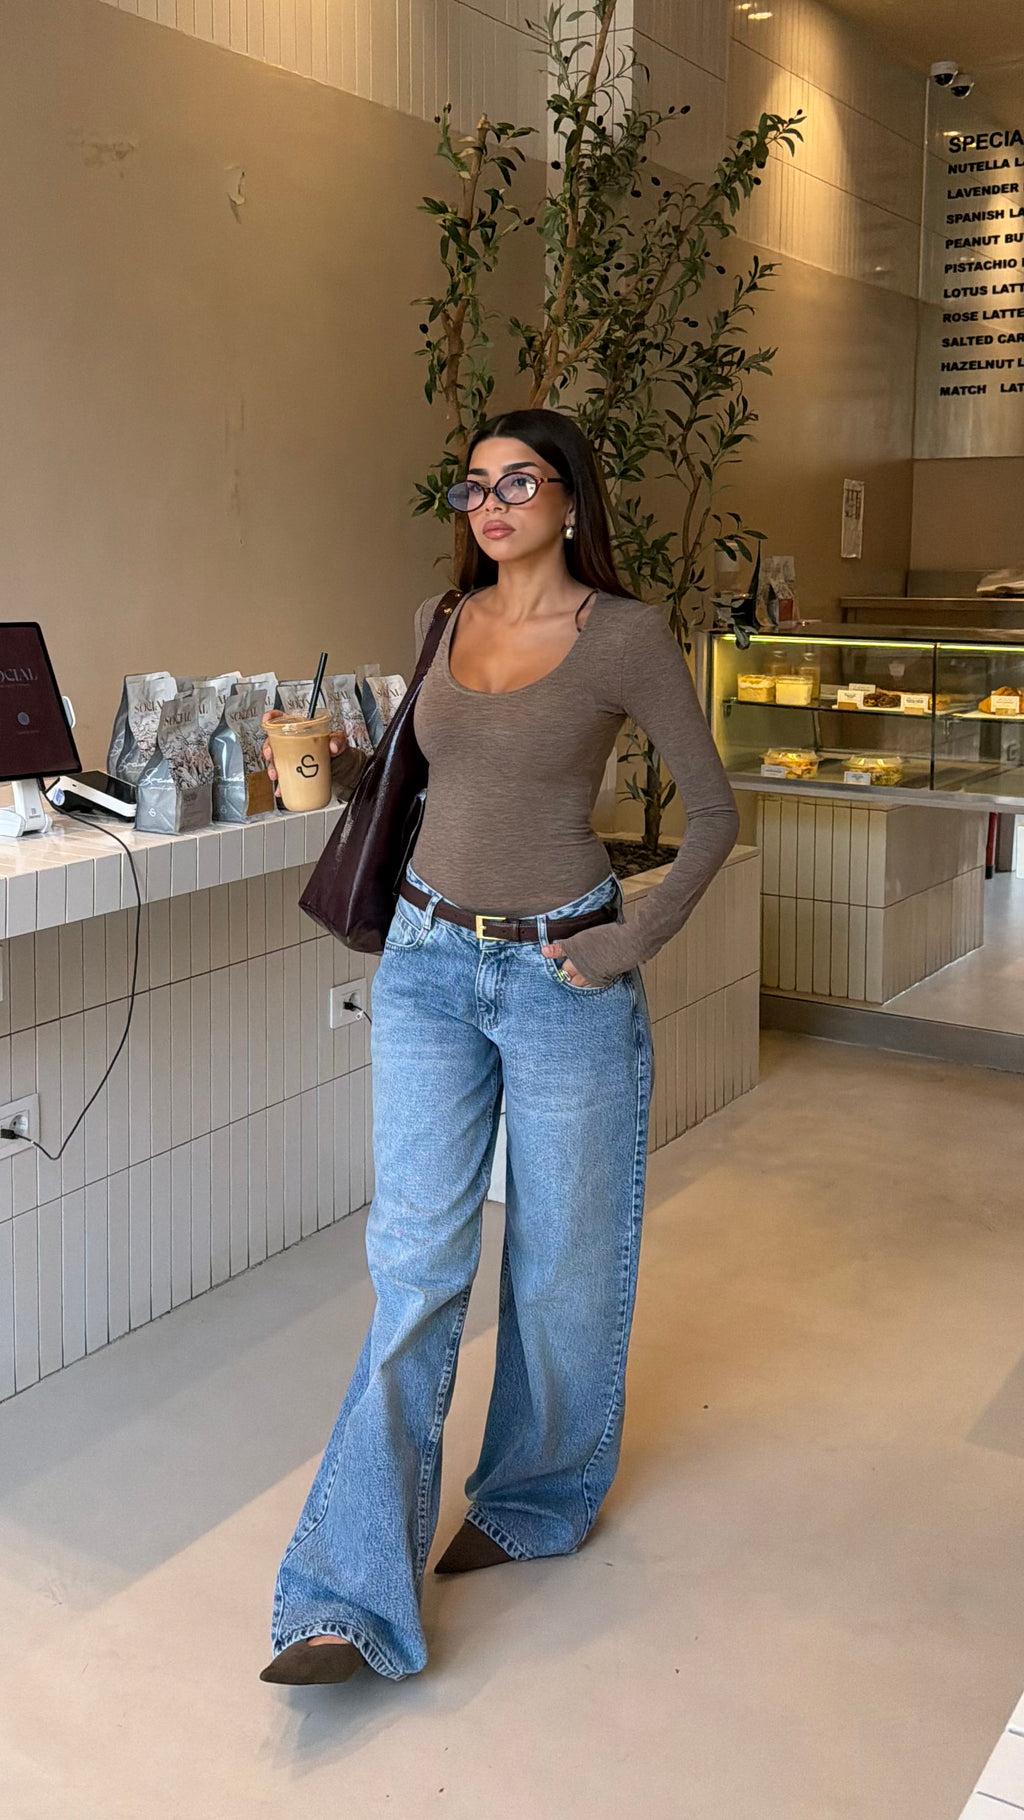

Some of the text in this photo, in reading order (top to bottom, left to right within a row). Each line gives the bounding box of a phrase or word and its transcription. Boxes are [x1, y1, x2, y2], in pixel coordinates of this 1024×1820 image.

[948, 130, 1024, 153] SPECIA
[948, 159, 1010, 174] NUTELLA
[947, 183, 1019, 199] LAVENDER
[946, 210, 1004, 224] SPANISH
[945, 235, 1000, 249] PEANUT
[944, 259, 1017, 274] PISTACHIO
[943, 283, 1024, 299] LOTUS LATT
[942, 308, 1024, 323] ROSE LATTE
[941, 333, 1024, 348] SALTED CAR
[941, 359, 1014, 372] HAZELNUT
[940, 385, 987, 396] MATCH
